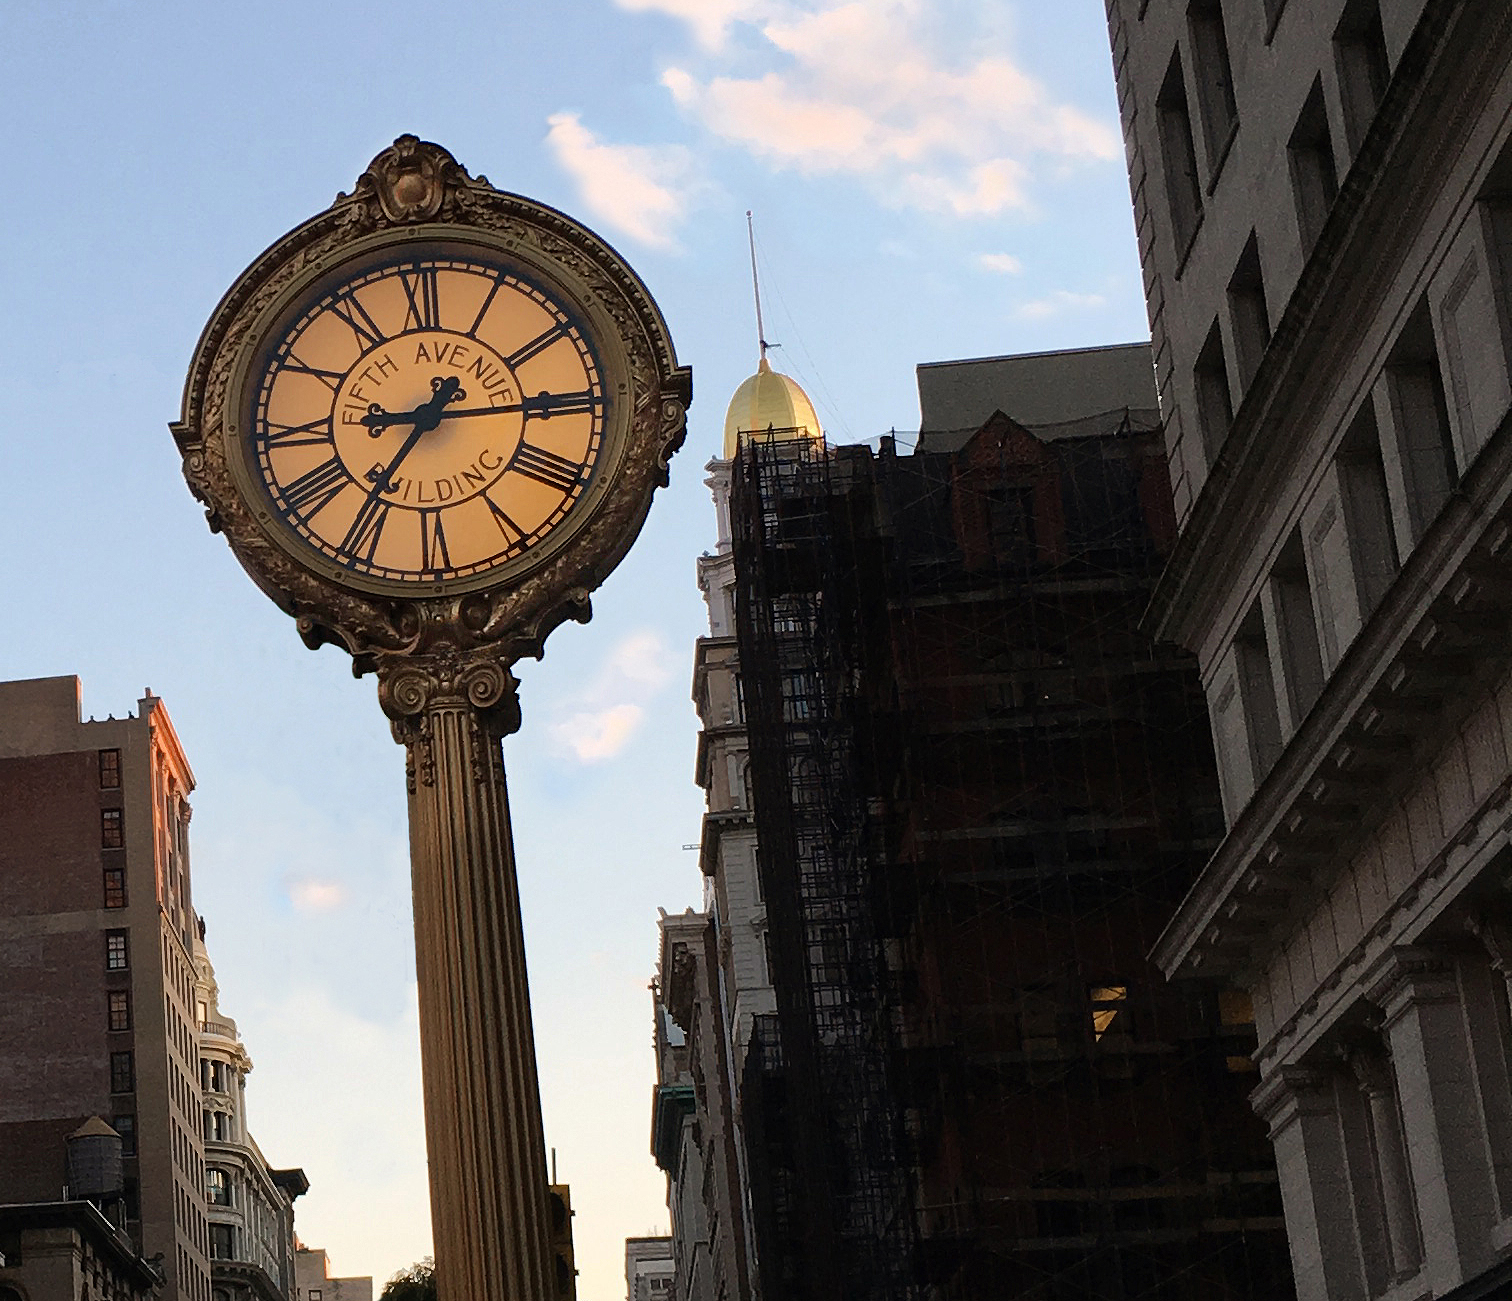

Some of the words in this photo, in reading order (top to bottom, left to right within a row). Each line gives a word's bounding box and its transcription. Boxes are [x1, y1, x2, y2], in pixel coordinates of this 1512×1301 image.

[342, 353, 400, 426] FIFTH
[415, 342, 515, 408] AVENUE
[363, 448, 504, 504] BILDING
